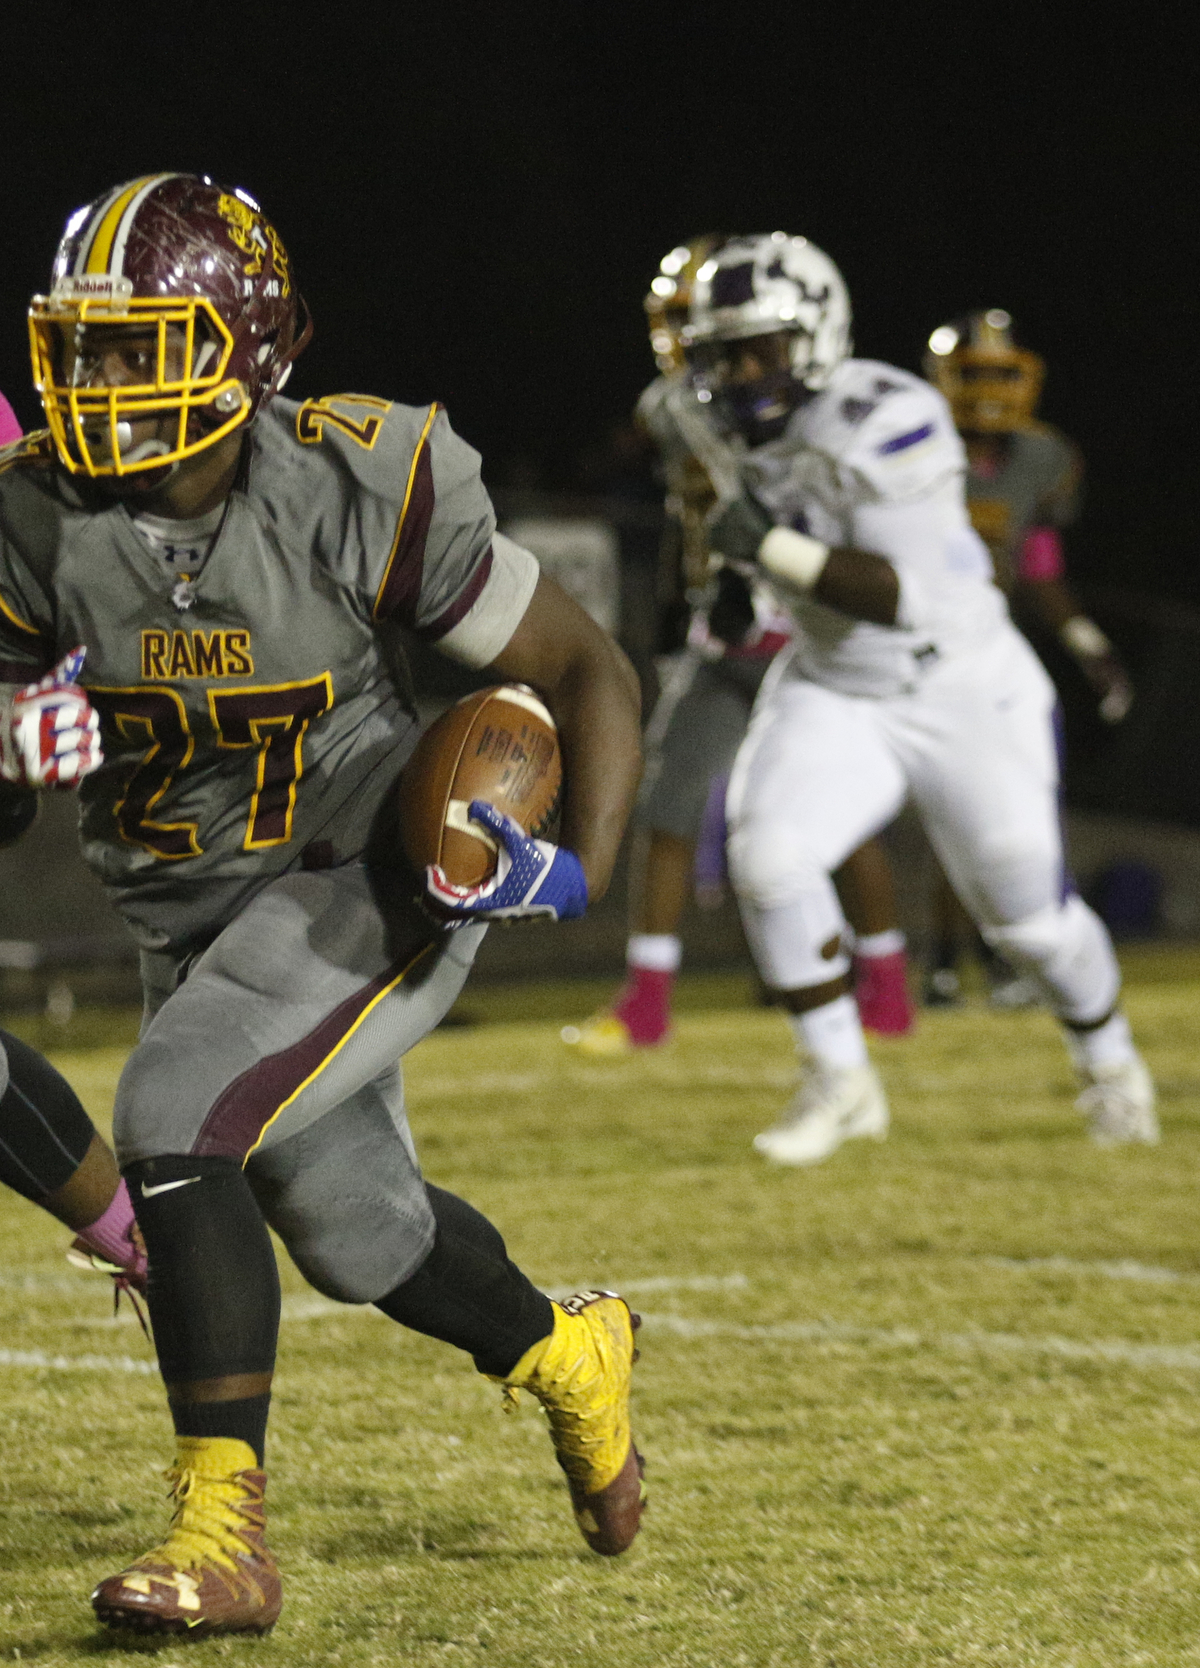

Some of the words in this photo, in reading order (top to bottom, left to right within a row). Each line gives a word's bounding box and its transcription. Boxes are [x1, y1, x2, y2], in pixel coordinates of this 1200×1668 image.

[73, 280, 112, 293] Riddell
[243, 278, 279, 297] RMS
[140, 628, 254, 680] RAMS
[83, 670, 334, 861] 27
